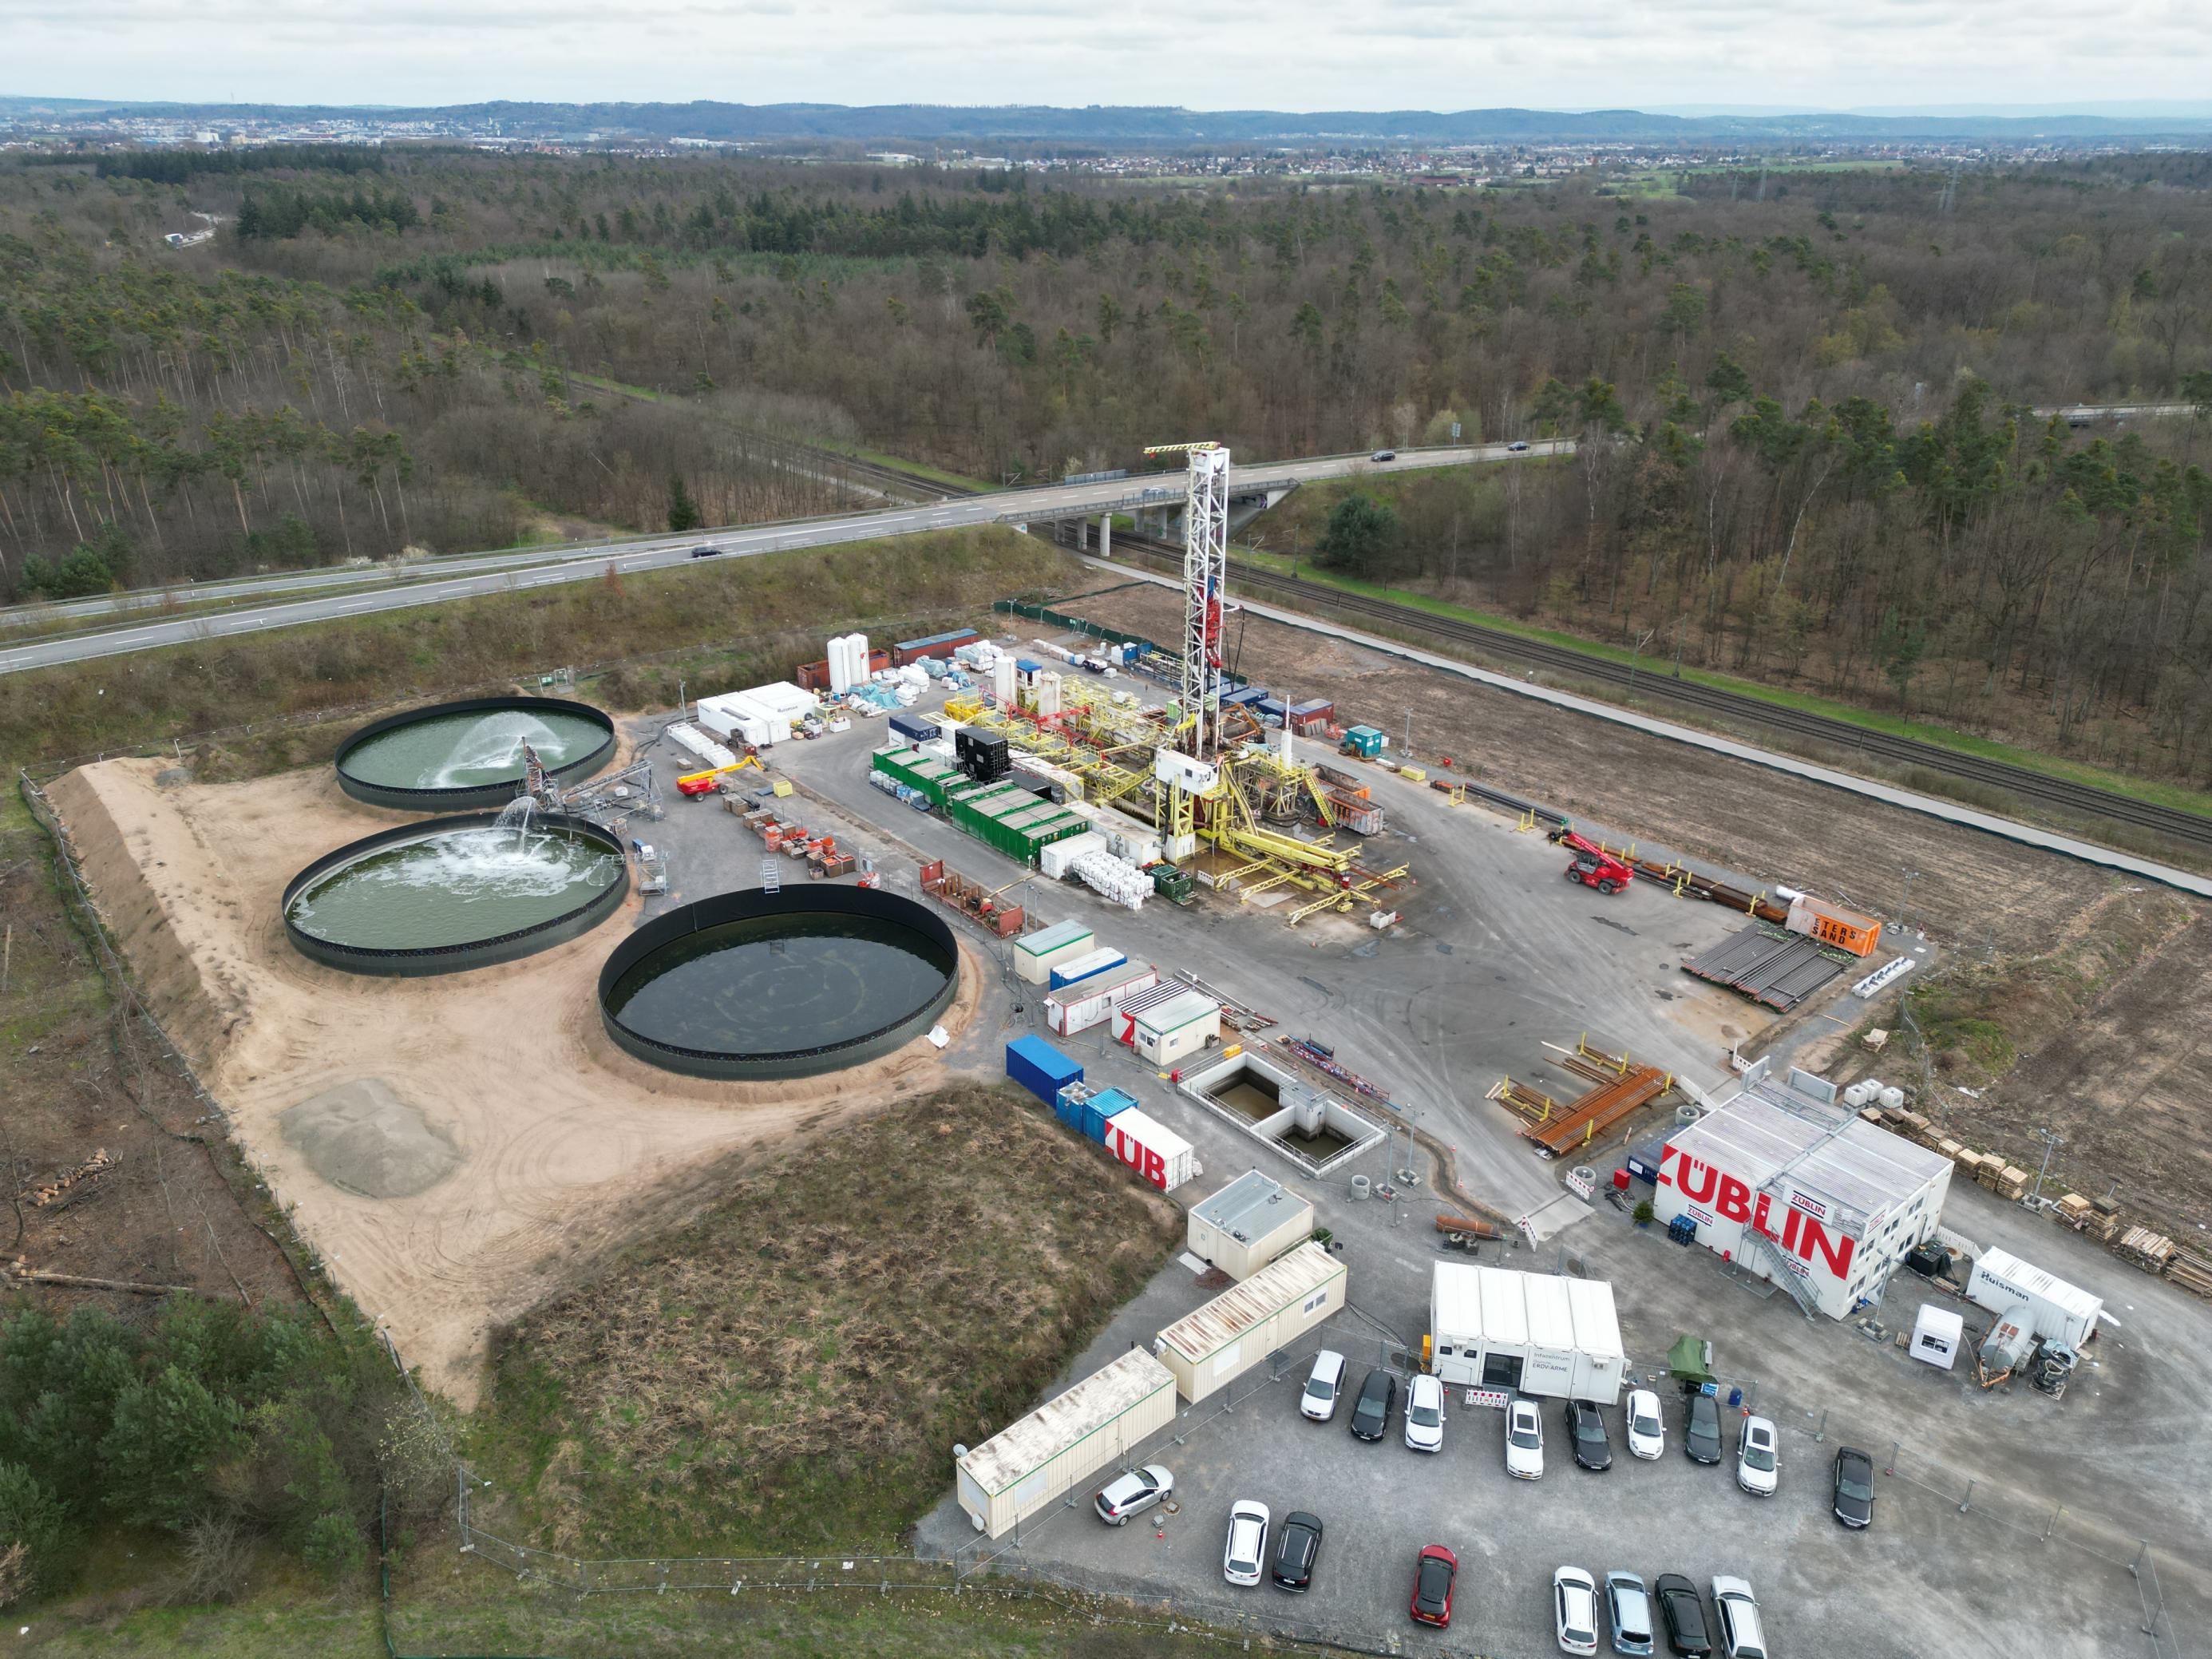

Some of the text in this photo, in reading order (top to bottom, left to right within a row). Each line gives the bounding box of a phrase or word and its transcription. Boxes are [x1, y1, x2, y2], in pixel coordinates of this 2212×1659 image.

[1811, 926, 1846, 944] SAND
[1791, 1194, 1826, 1216] ZÜBLIN
[1688, 1206, 1713, 1224] ZÜBLIN
[1787, 1260, 1810, 1277] ÜBLIN
[1981, 1271, 2029, 1301] Huisman
